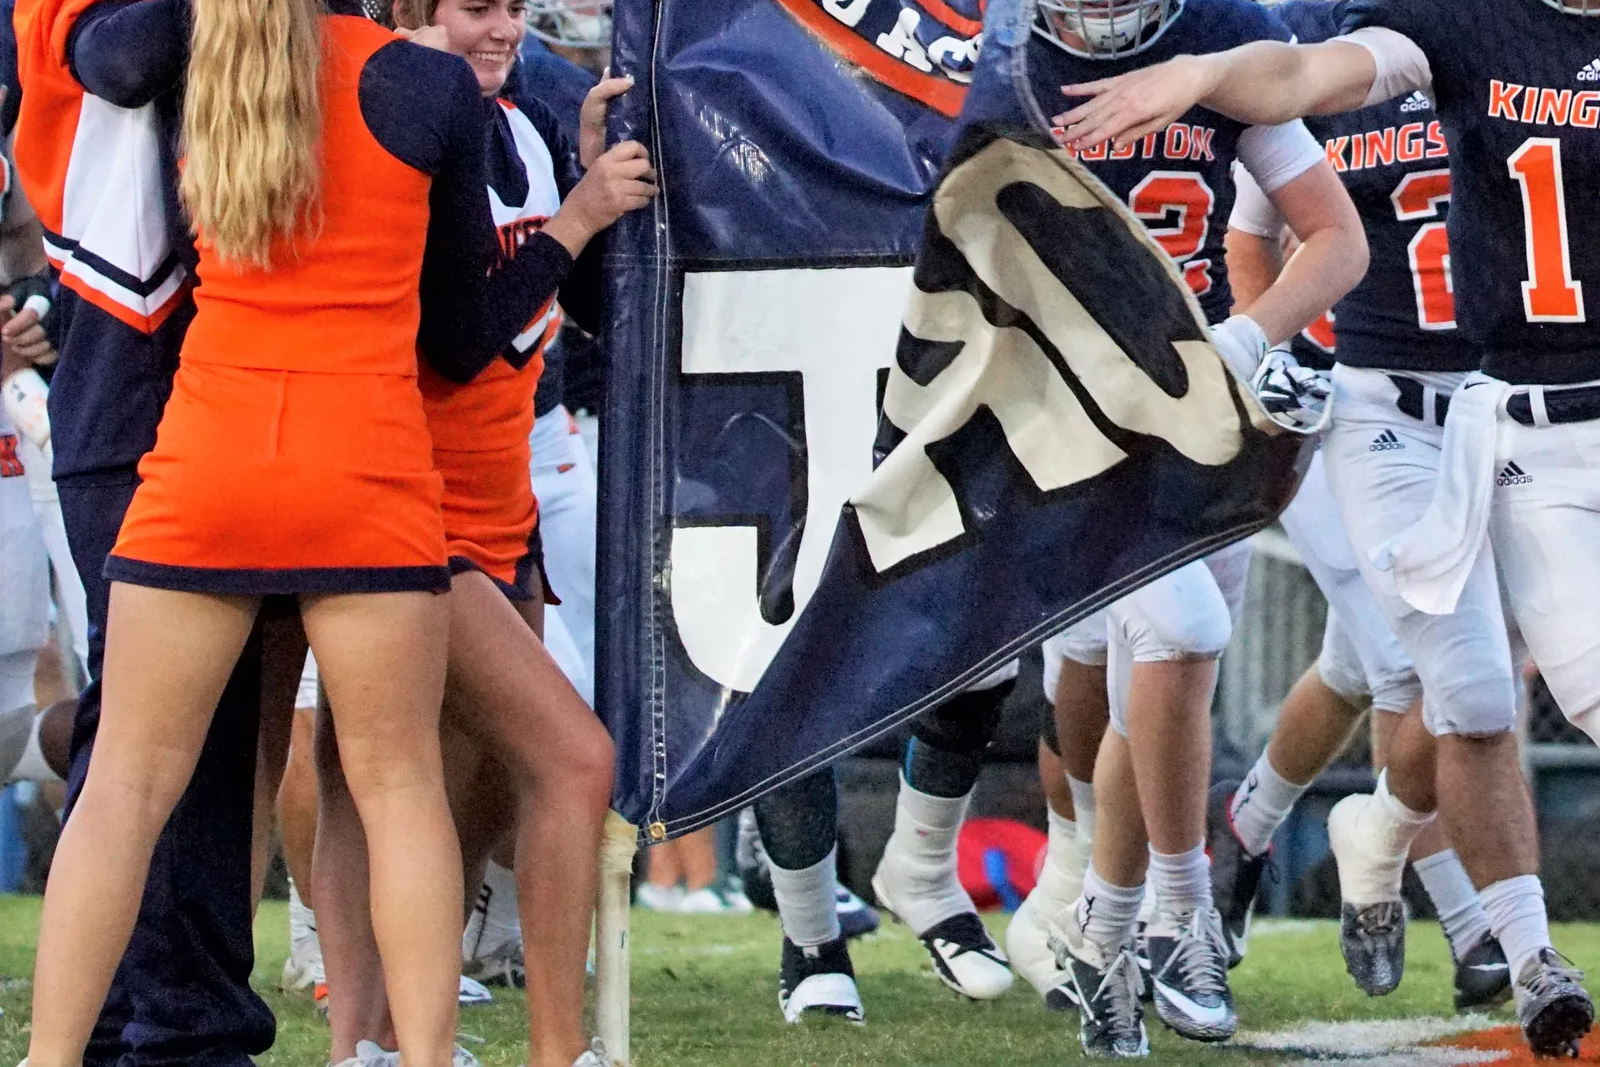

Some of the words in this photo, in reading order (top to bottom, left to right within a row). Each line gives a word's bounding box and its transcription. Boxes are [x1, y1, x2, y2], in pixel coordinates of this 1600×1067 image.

[1400, 100, 1429, 112] adid
[1324, 120, 1449, 173] KINGS
[1369, 443, 1406, 452] adidas
[1497, 475, 1533, 486] adidas
